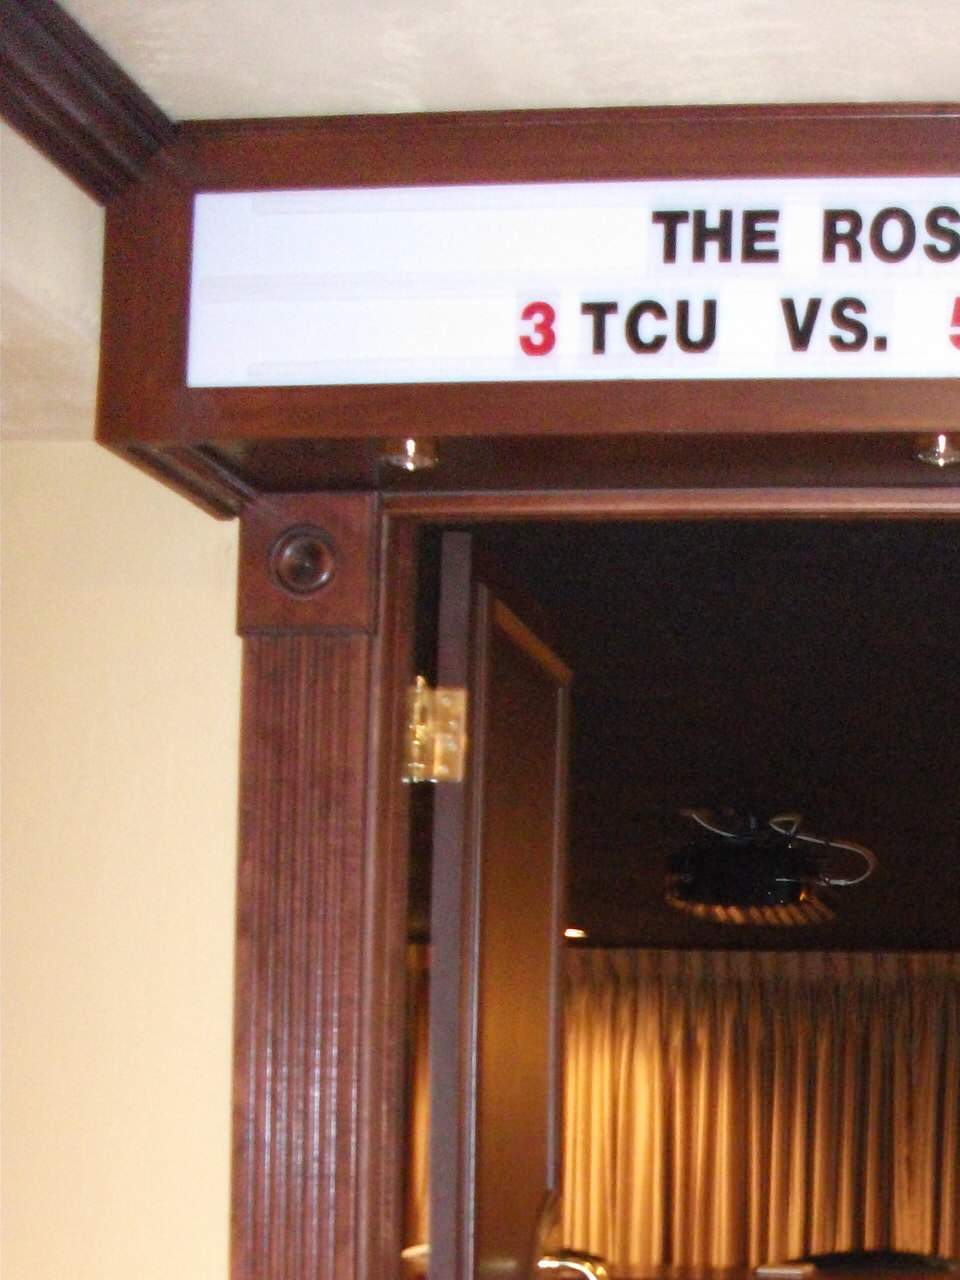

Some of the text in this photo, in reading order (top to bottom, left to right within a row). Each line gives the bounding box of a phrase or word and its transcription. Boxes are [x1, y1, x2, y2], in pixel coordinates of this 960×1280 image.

[651, 208, 781, 265] THE
[518, 300, 557, 358] 3
[580, 298, 718, 356] TCU
[780, 295, 889, 353] VS.
